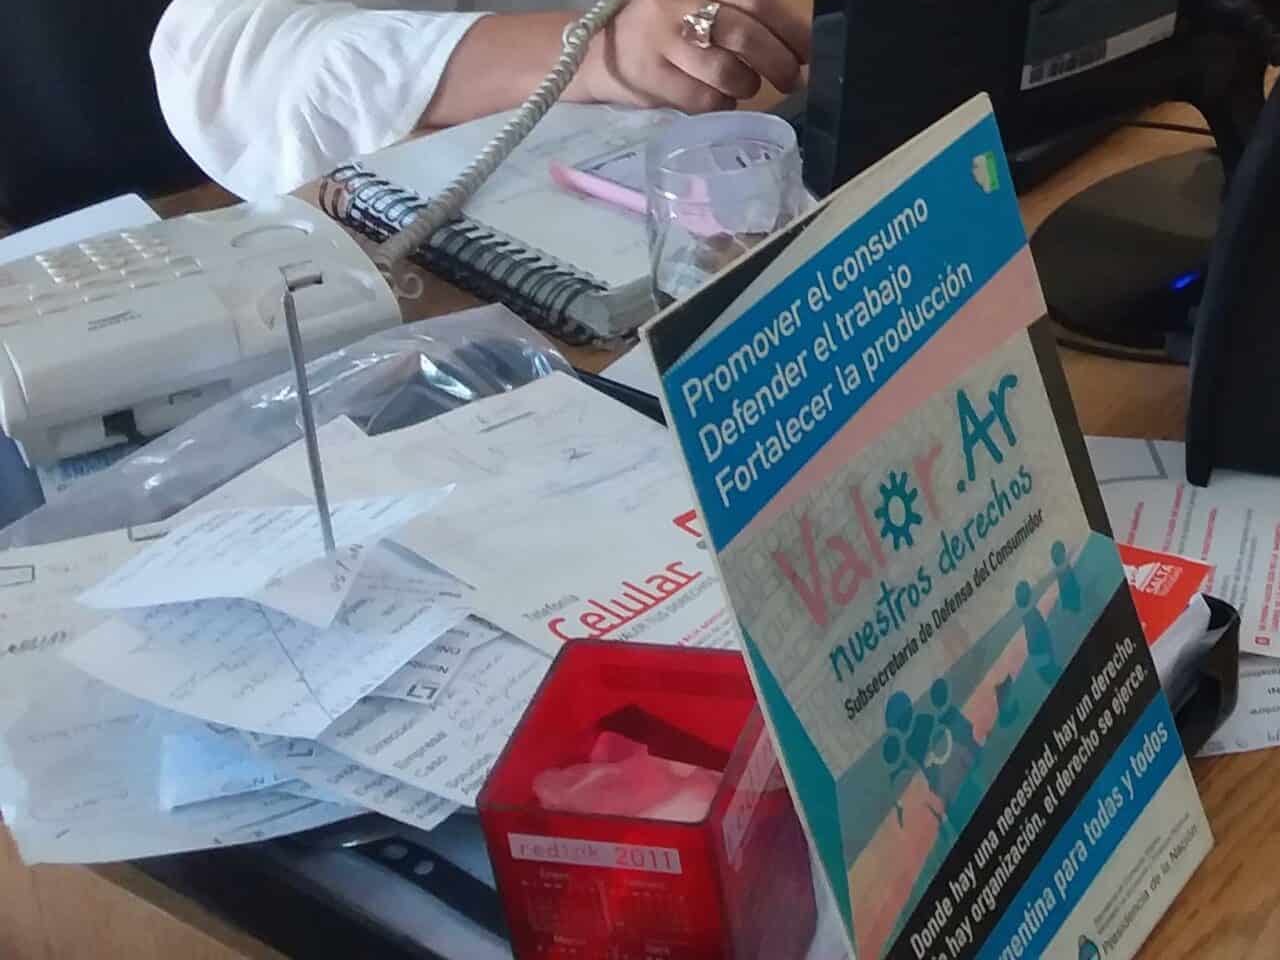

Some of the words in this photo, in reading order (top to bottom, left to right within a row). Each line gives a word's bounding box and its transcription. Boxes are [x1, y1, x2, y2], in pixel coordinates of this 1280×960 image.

[682, 298, 803, 418] Promover
[807, 271, 831, 313] el
[832, 198, 928, 291] consumo
[699, 349, 809, 463] Defender
[813, 322, 838, 363] el
[835, 264, 912, 342] trabajo
[715, 383, 834, 508] Fortalecer
[835, 365, 862, 397] la
[862, 258, 974, 383] producción
[547, 561, 702, 642] Celular
[829, 565, 932, 682] nuestros
[939, 464, 1033, 575] derechos
[918, 621, 934, 645] de
[931, 580, 974, 631] Defensa
[972, 561, 990, 594] del
[988, 508, 1044, 573] Consumidor
[615, 846, 674, 871] 2011
[910, 895, 954, 960] Donde
[949, 861, 977, 904] hay
[973, 829, 1000, 871] una
[1052, 715, 1079, 752] hay
[1075, 693, 1093, 723] un
[945, 916, 974, 959] hay
[1043, 785, 1059, 815] el
[1054, 728, 1100, 798] derecho
[1097, 709, 1114, 735] se
[1053, 839, 1088, 901] para
[1084, 785, 1125, 846] todas
[1120, 770, 1137, 801] y
[1129, 721, 1169, 779] todos
